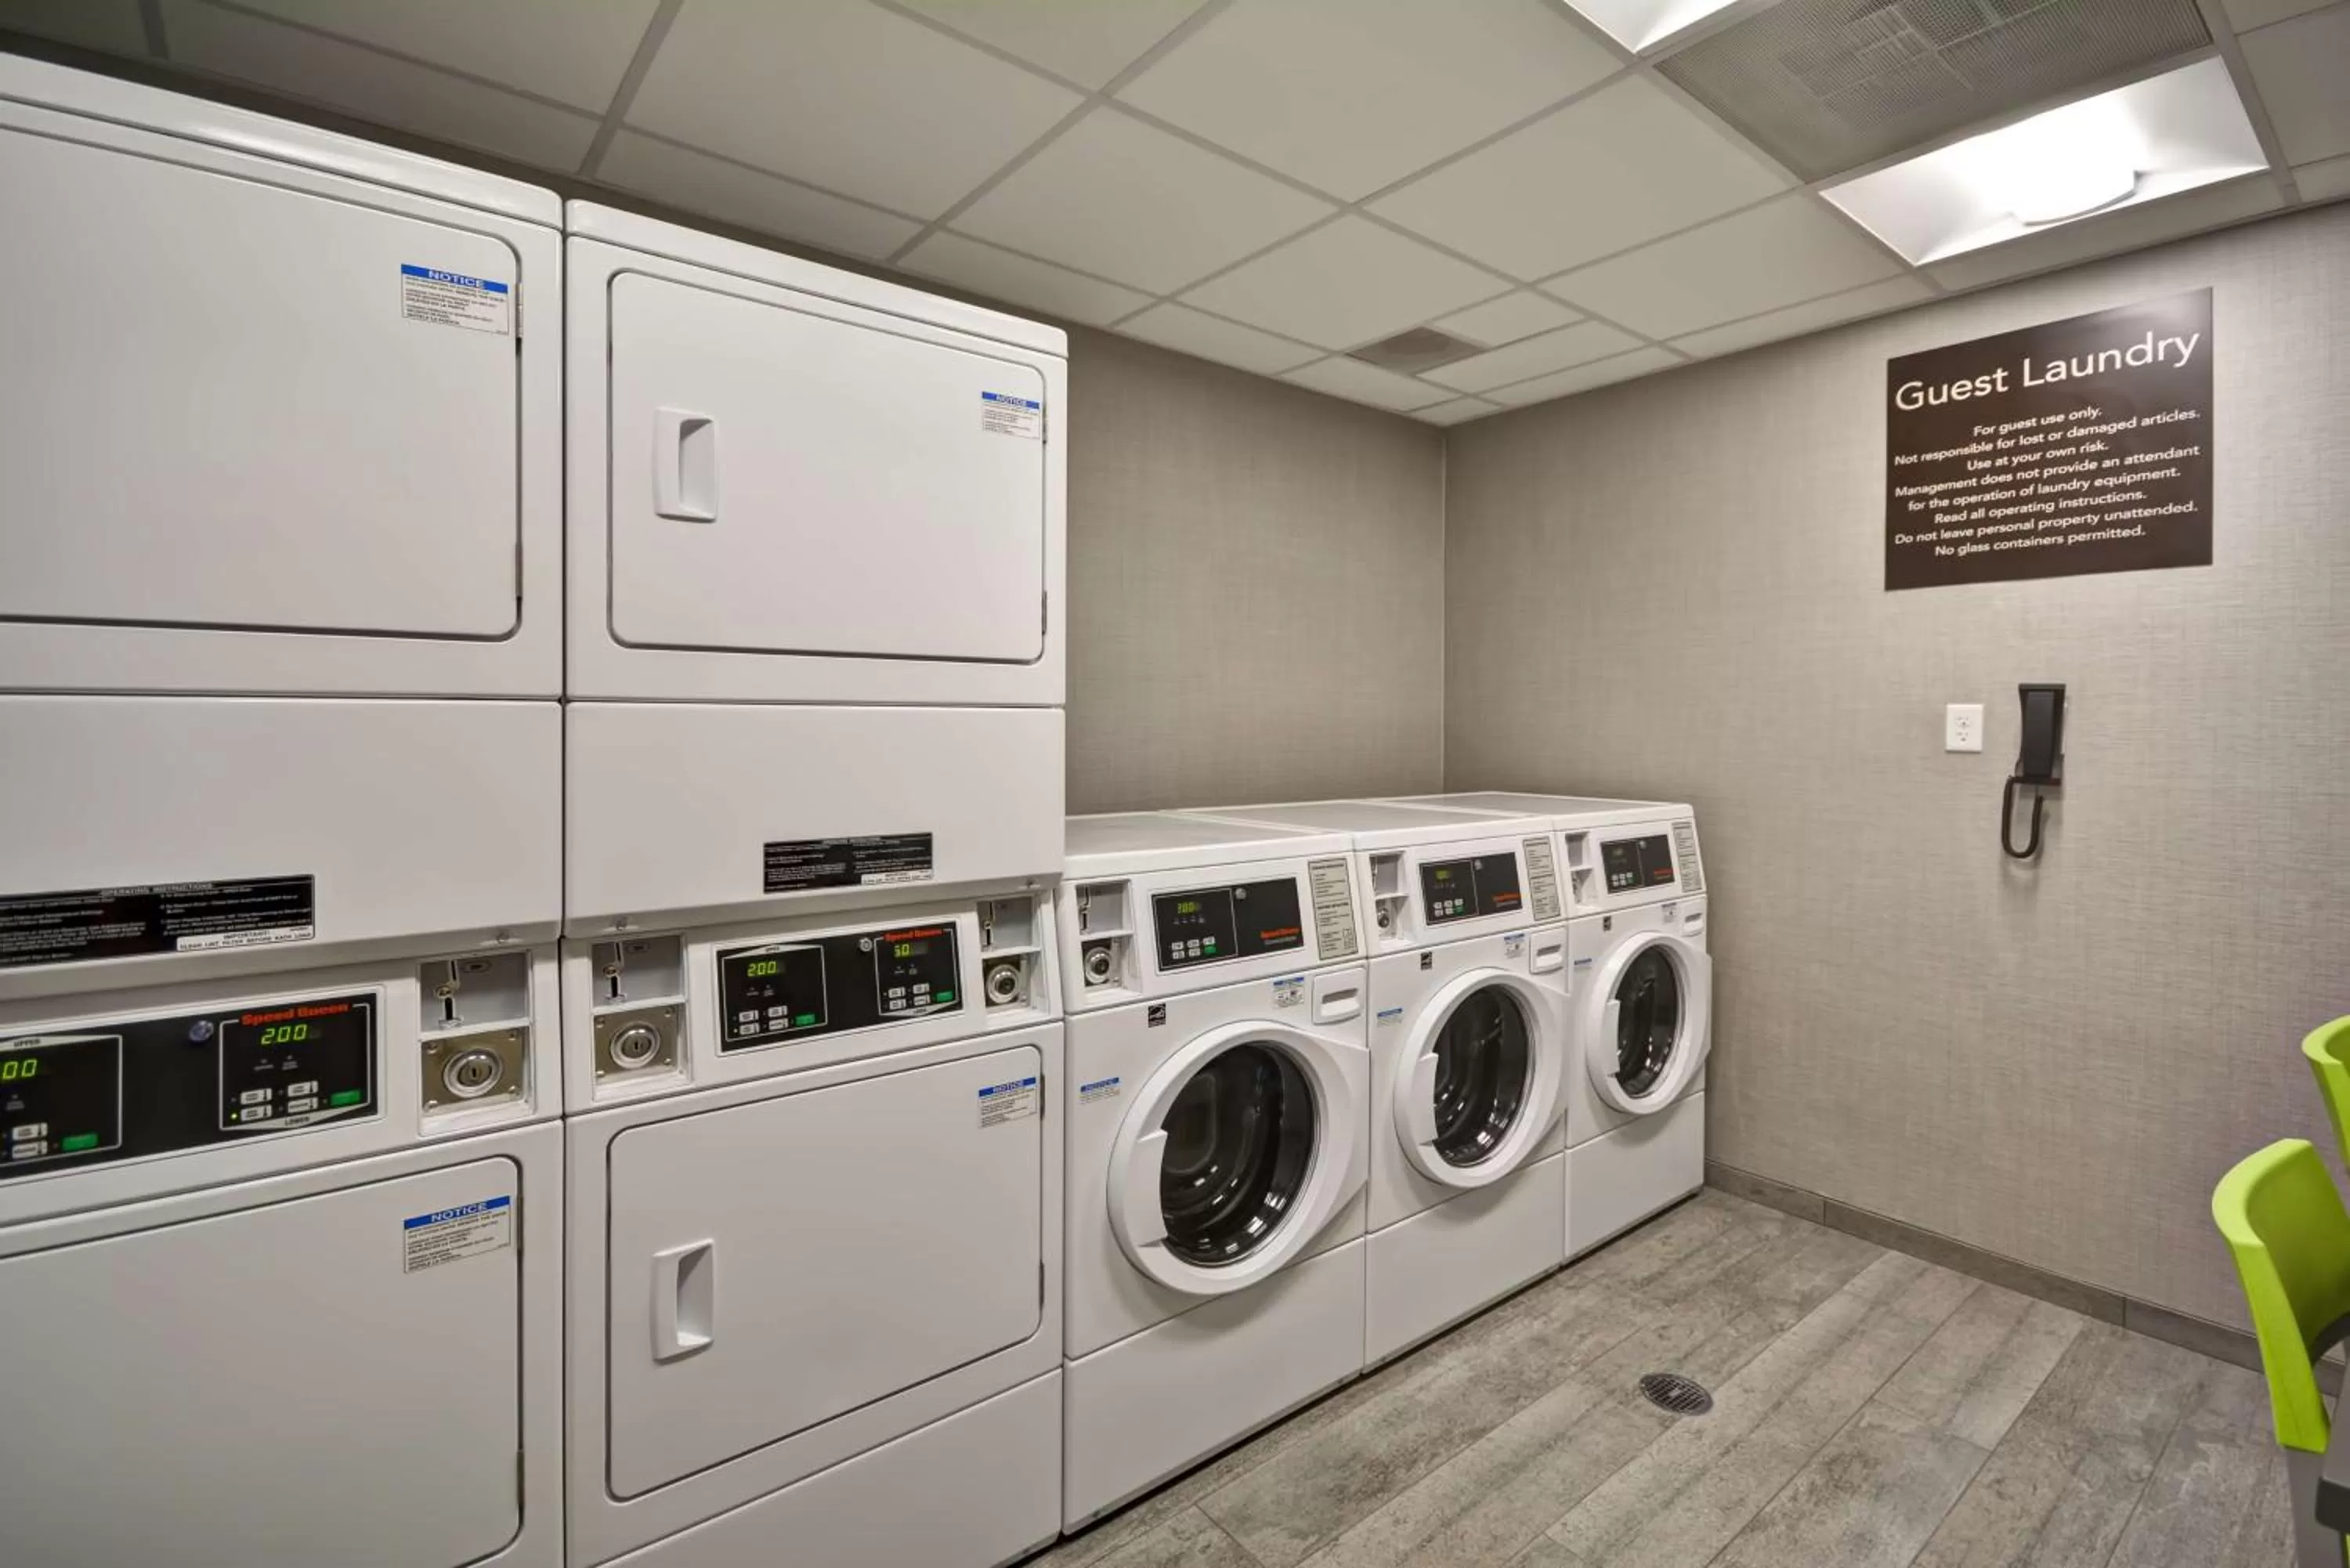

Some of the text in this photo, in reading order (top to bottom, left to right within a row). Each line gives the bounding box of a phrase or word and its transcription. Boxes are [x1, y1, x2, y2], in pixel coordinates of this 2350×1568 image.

[428, 270, 484, 287] NOTICE
[1895, 331, 2200, 410] Guest Laundry
[1894, 409, 2200, 465] Not responsible for lost or damaged articles.
[1973, 406, 2102, 436] For guest use only.
[1967, 439, 2109, 471] Use at your own risk.
[1895, 446, 2200, 497] Management does not provide an attendant
[1908, 467, 2181, 511] for the operation of laundry equipment.
[1895, 500, 2198, 544] Do not leave personal property unattended.
[1934, 490, 2148, 524] Read all operating instructions.
[1935, 524, 2146, 557] No glass containers permitted.
[747, 961, 776, 977] 200
[241, 1004, 350, 1025] Speed Queen
[261, 1024, 307, 1045] 200
[432, 1202, 487, 1223] NOTICE
